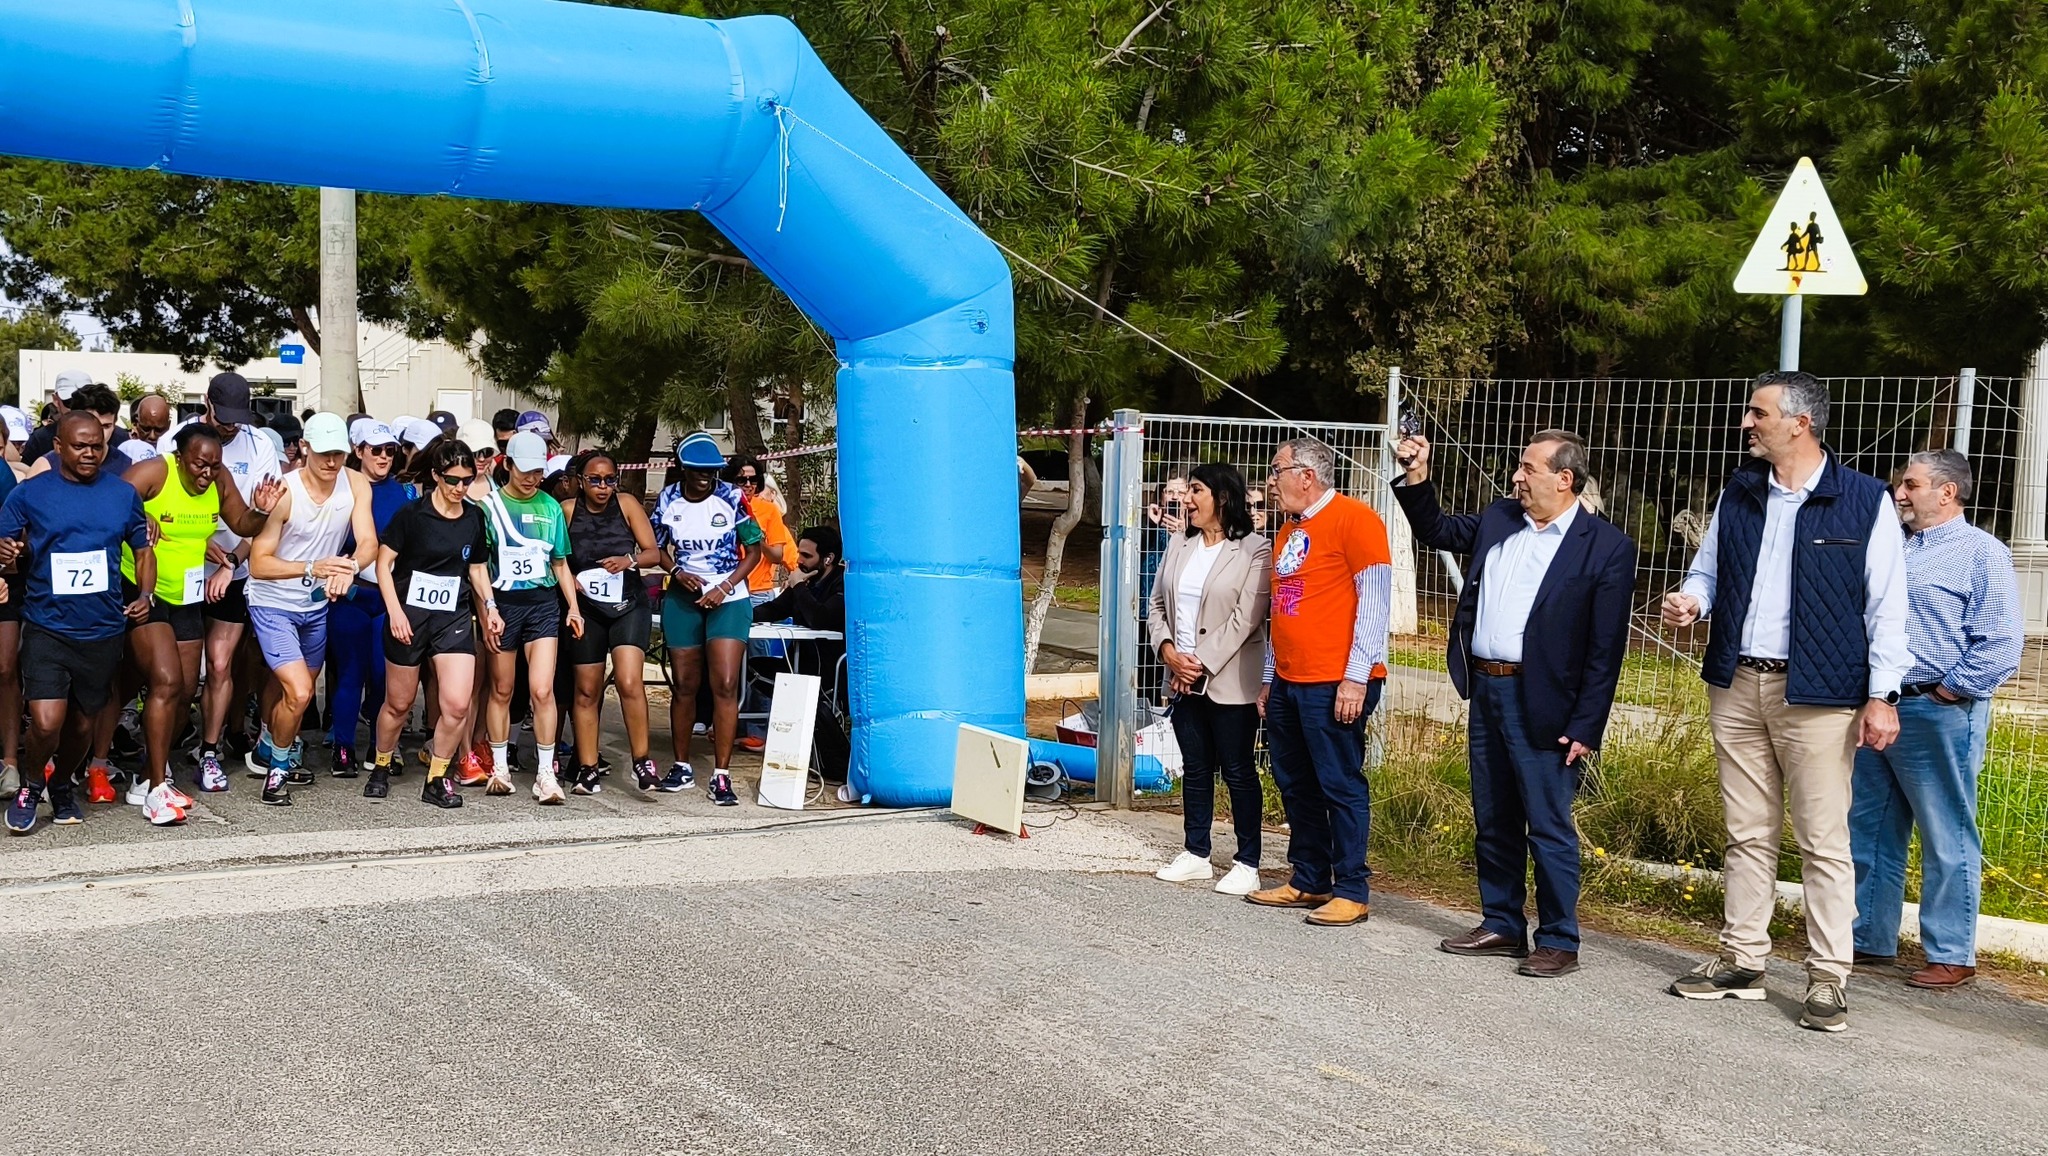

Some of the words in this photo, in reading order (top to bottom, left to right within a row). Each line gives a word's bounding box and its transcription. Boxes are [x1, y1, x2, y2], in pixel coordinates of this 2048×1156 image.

[675, 538, 725, 551] KENYA
[512, 558, 533, 576] 35
[67, 568, 94, 587] 72
[415, 586, 451, 605] 100
[589, 581, 611, 598] 51
